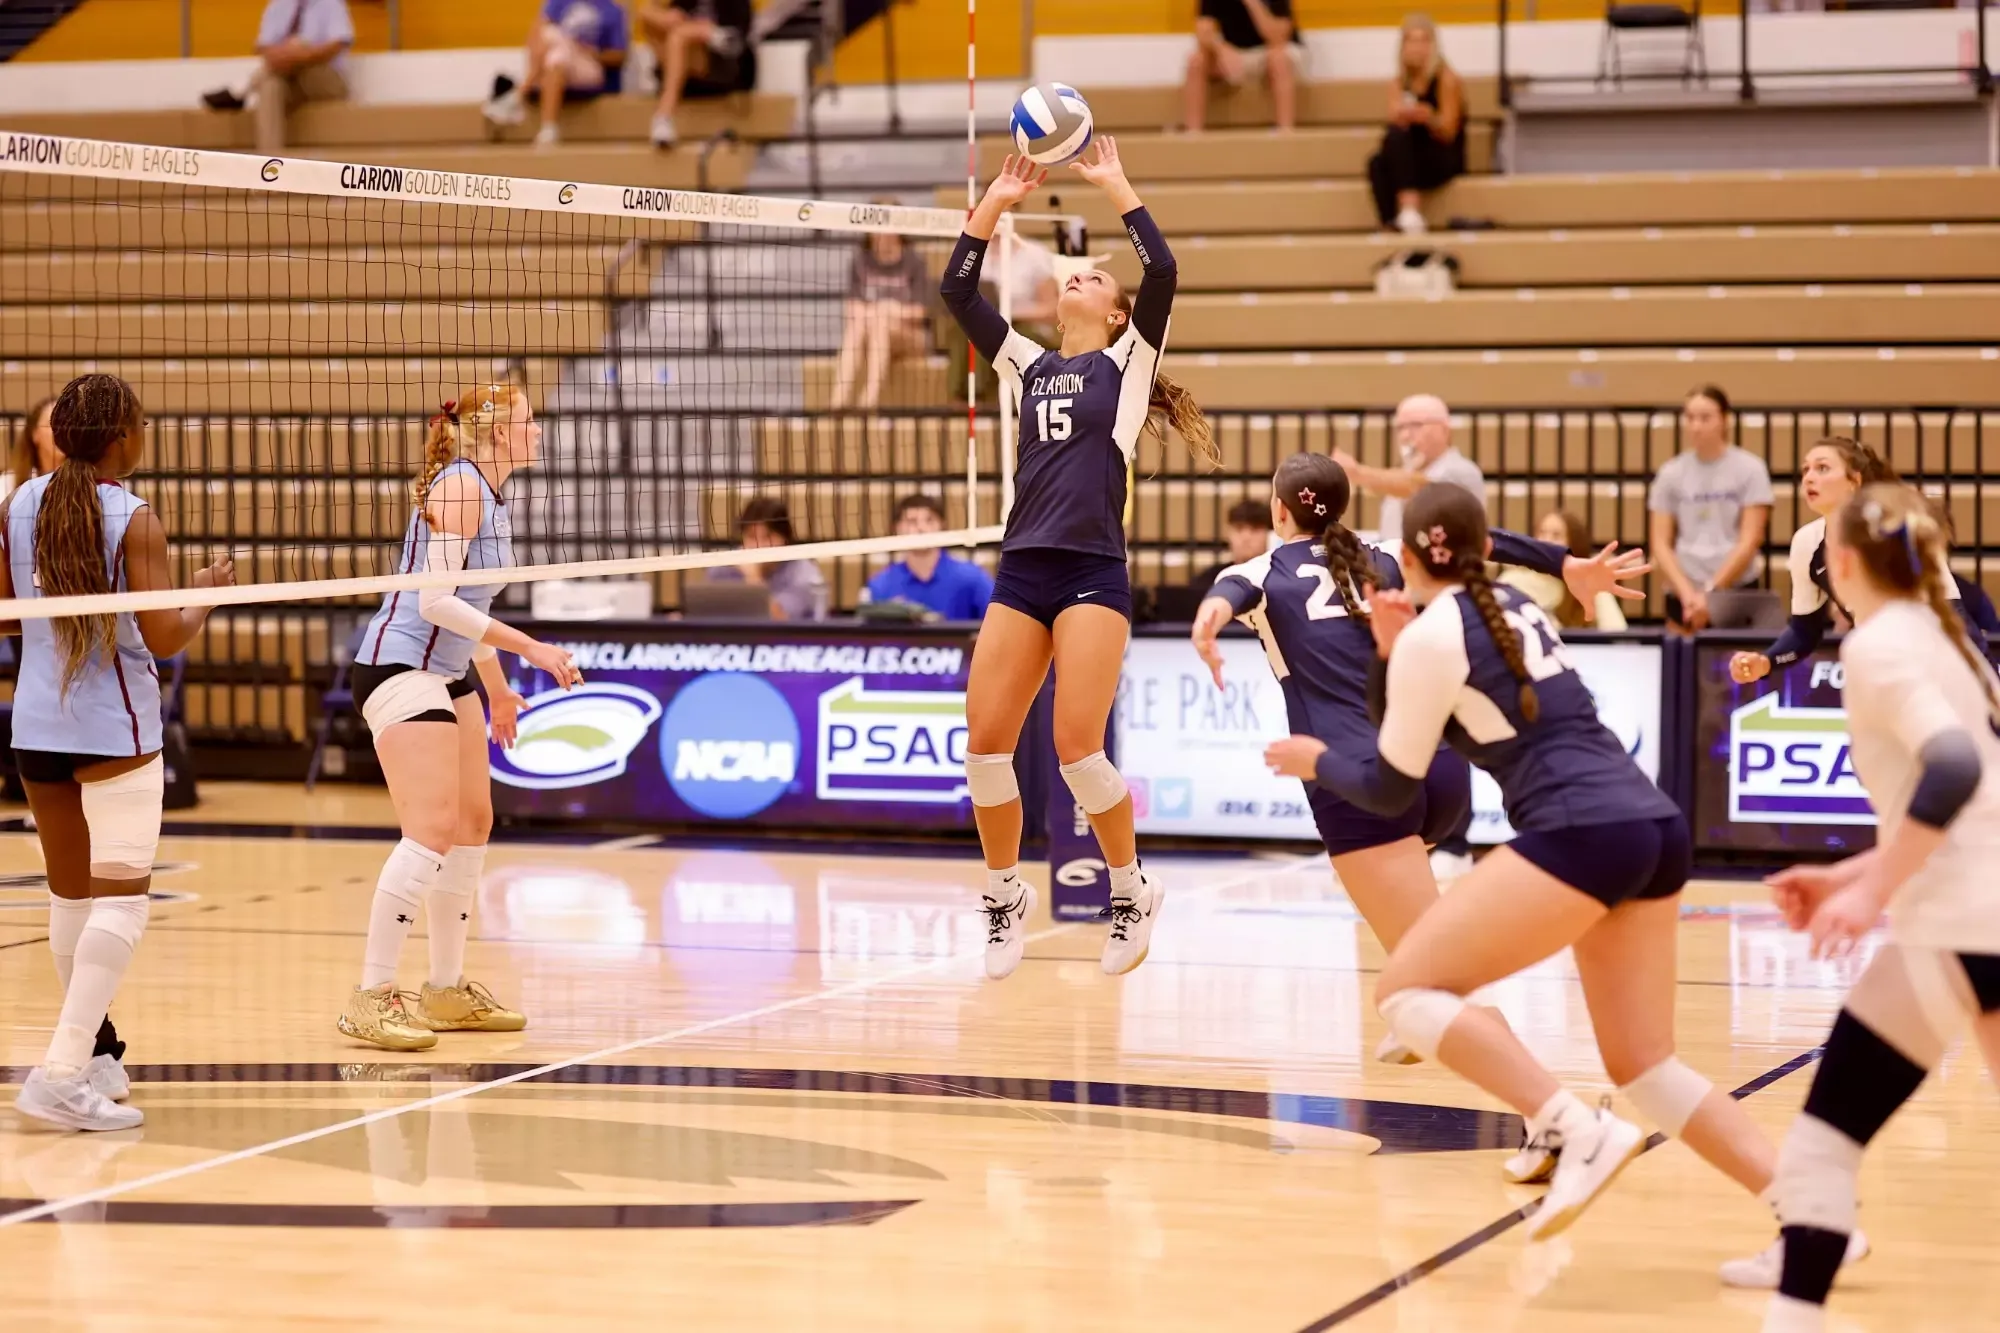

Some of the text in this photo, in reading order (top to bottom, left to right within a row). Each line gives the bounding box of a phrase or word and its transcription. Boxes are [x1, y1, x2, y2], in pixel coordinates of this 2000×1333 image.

[0, 135, 200, 176] LARION GOLDEN EAGLES
[340, 164, 512, 200] CLARION GOLDEN EAGLES
[622, 188, 760, 219] CLARION GOLDEN EAGLES
[850, 204, 890, 226] CLARION
[1031, 373, 1085, 396] CLARION
[1035, 398, 1074, 442] 15
[674, 739, 794, 783] NCAA
[1738, 742, 1856, 786] PSA
